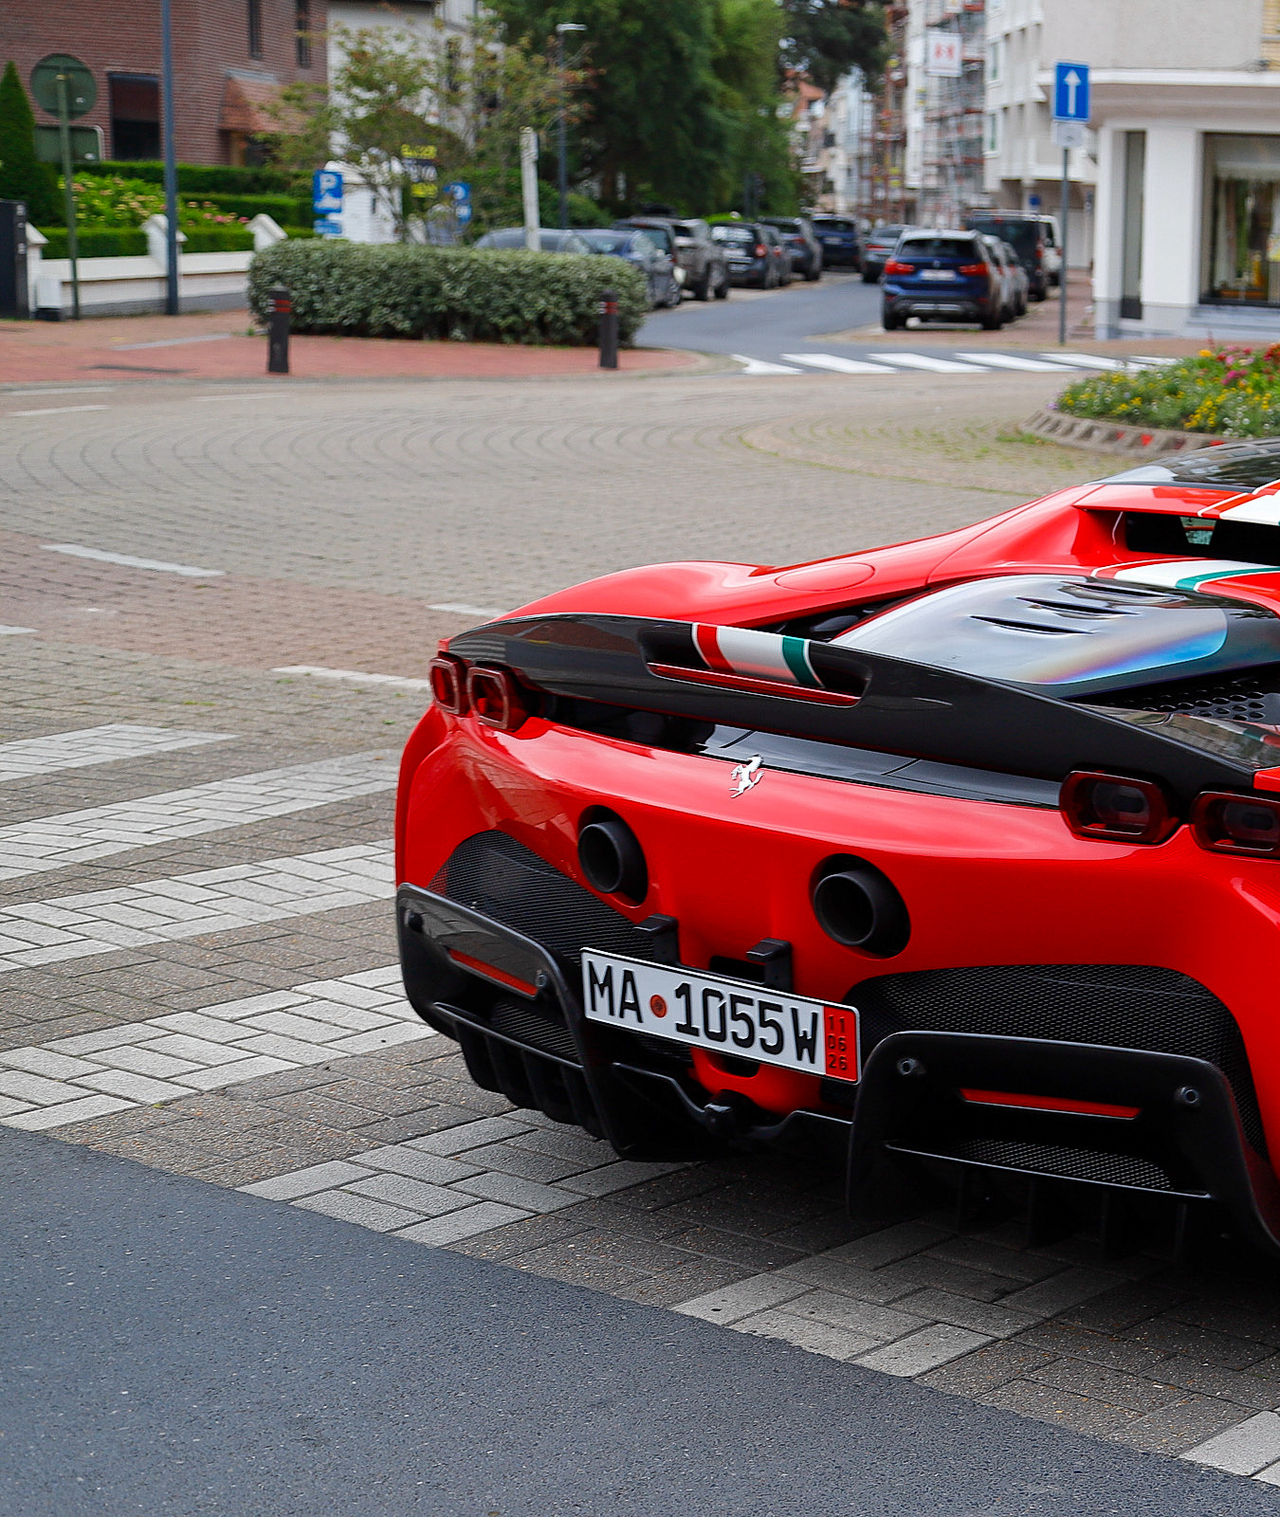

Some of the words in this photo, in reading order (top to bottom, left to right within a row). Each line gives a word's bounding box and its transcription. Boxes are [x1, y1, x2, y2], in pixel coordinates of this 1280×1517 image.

[587, 960, 643, 1023] MA
[827, 1014, 846, 1034] 11
[827, 1033, 847, 1052] 06
[827, 1052, 848, 1071] 26
